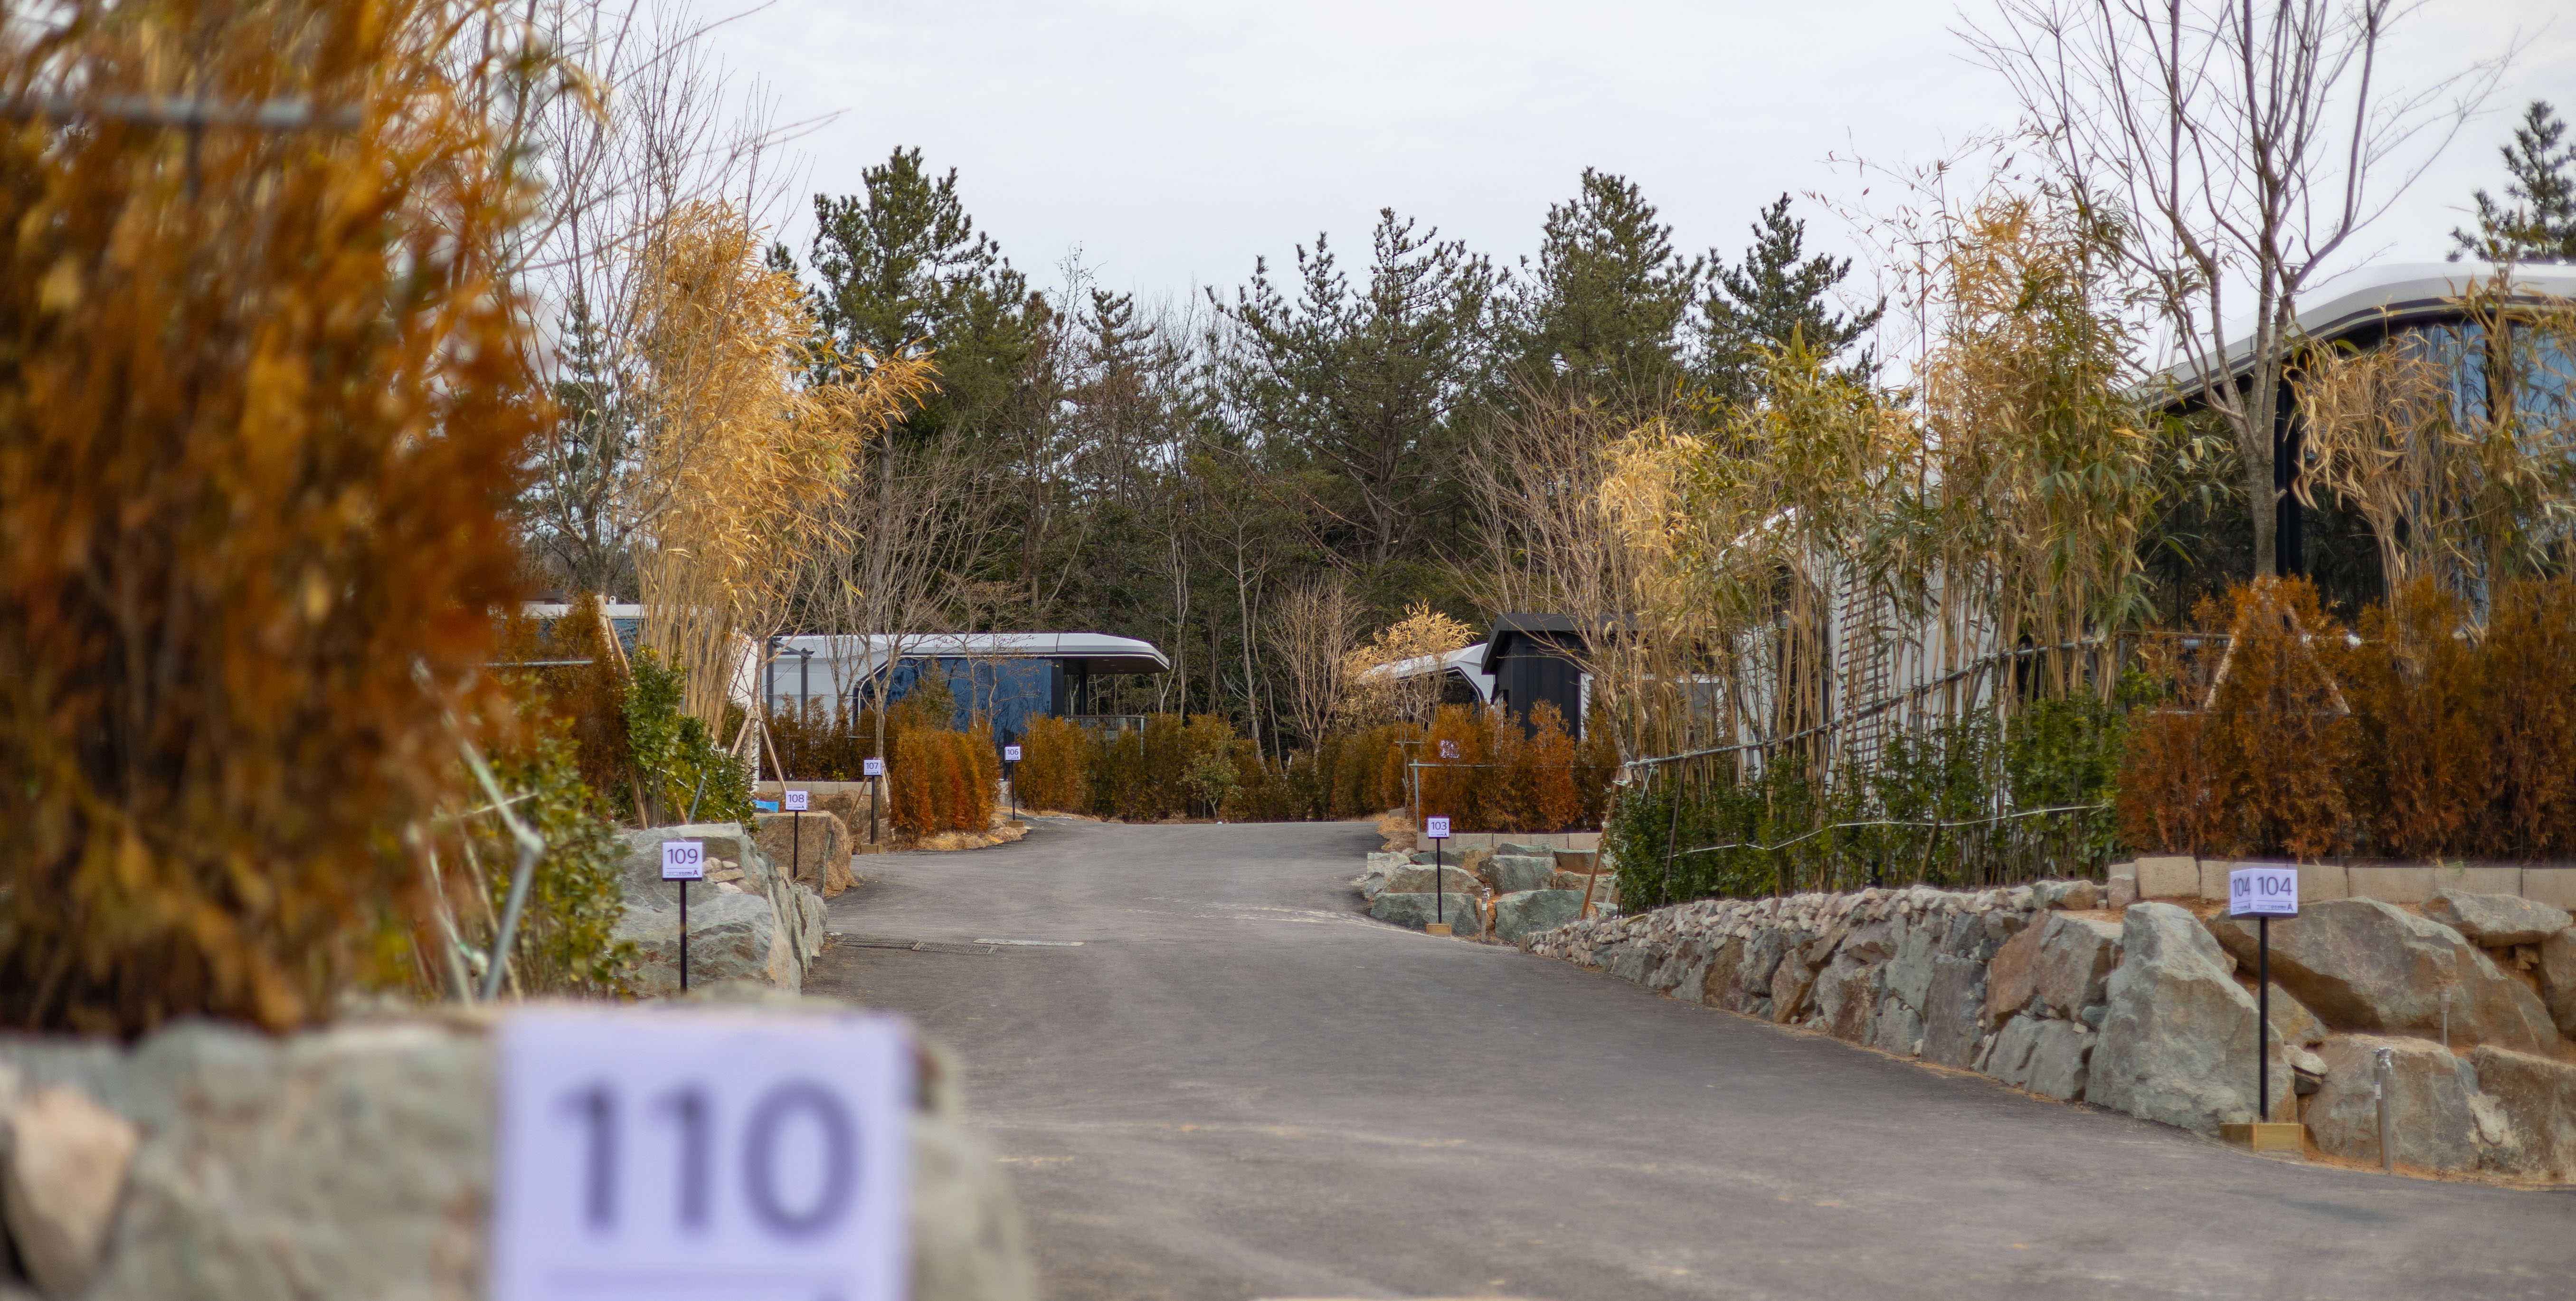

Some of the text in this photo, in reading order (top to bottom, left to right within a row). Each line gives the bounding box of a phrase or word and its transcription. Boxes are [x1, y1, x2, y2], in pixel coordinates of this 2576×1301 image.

[788, 794, 805, 803] 108
[1431, 822, 1447, 830] 103
[667, 848, 698, 864] 109
[2233, 877, 2251, 897] 104
[2257, 876, 2292, 896] 104
[553, 1077, 861, 1241] 110
